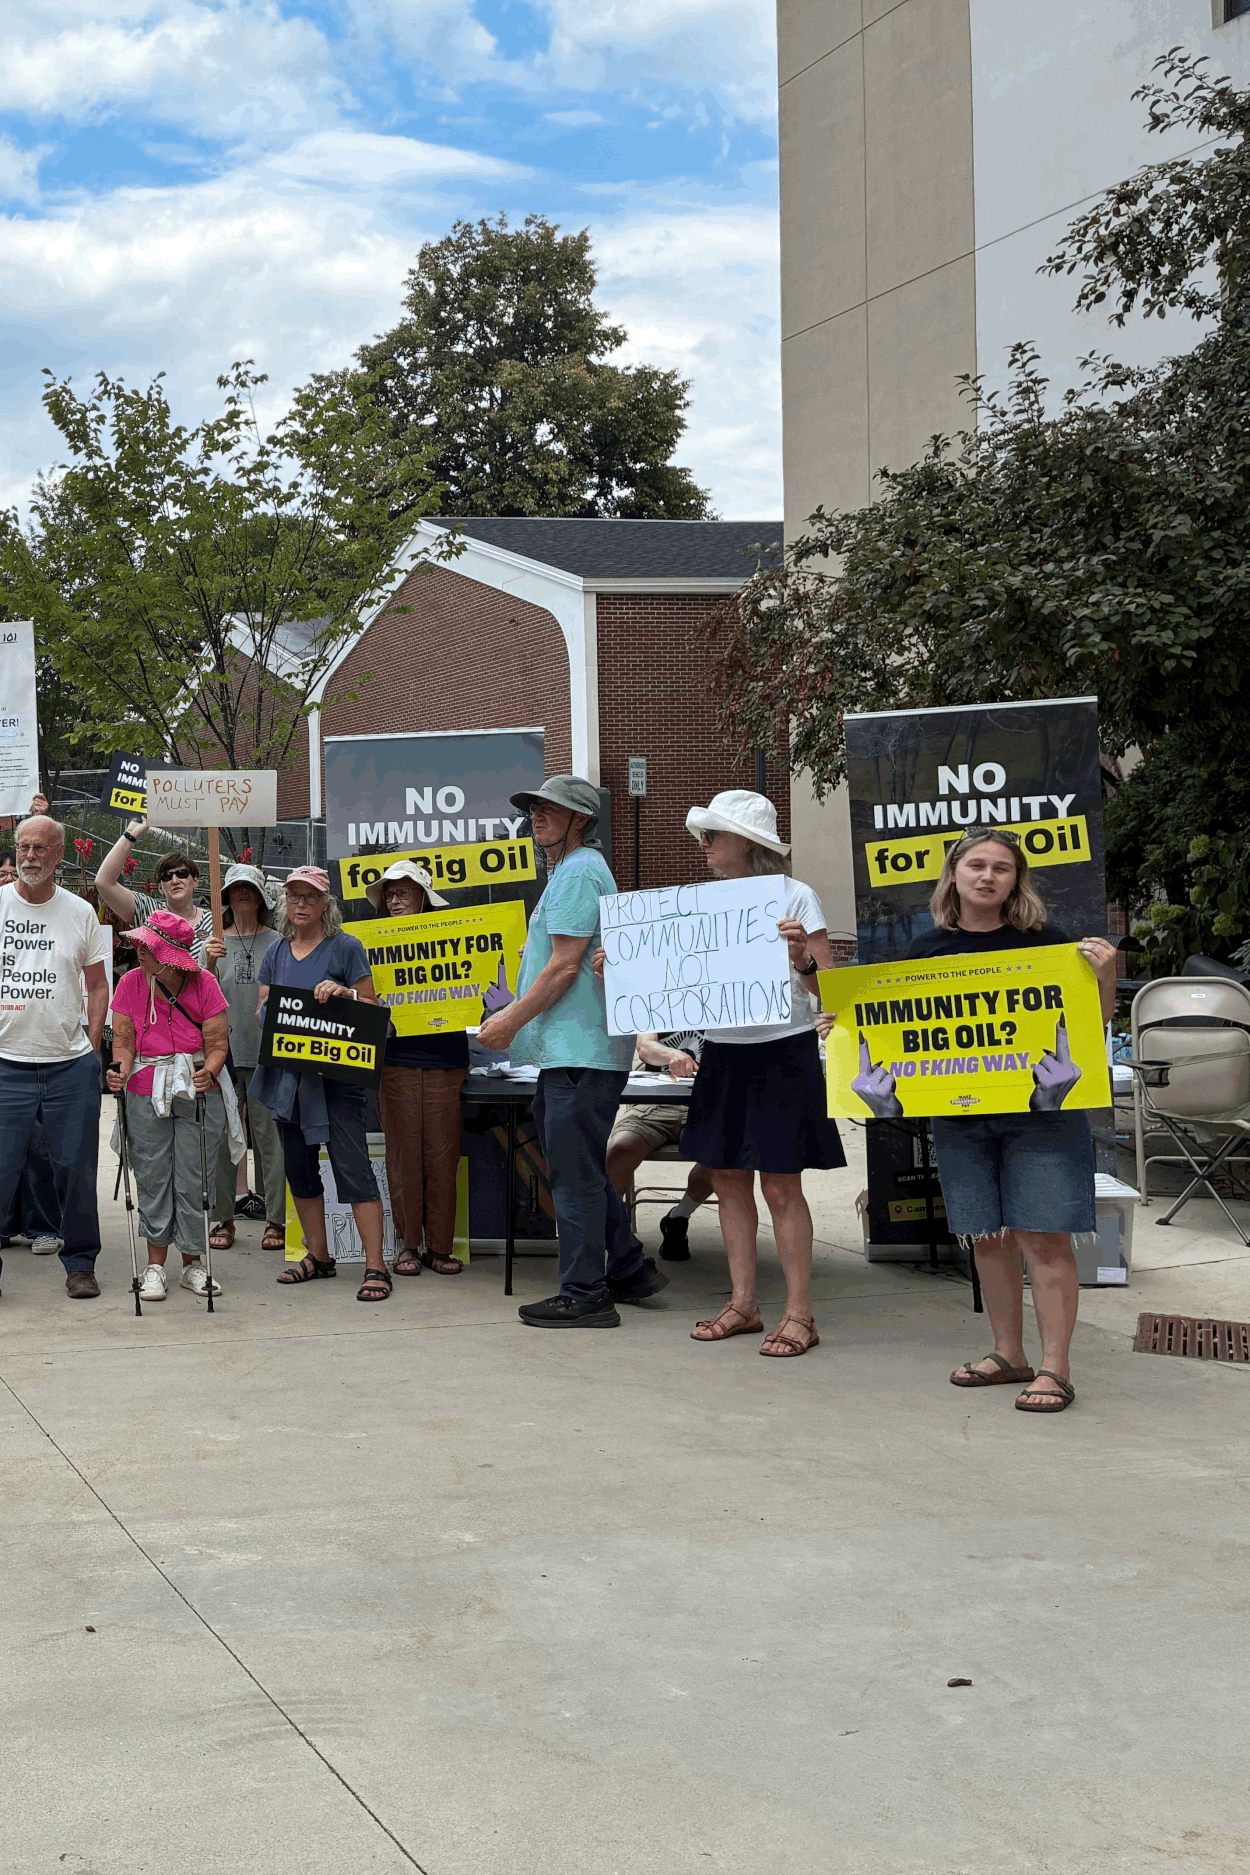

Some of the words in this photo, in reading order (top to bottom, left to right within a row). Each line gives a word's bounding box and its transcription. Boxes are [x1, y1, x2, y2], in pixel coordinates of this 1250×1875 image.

[3, 633, 17, 643] 101
[120, 760, 139, 773] NO
[937, 762, 1007, 795] NO
[114, 791, 137, 807] for
[152, 778, 252, 795] POLLUTERS
[156, 796, 205, 811] MUST
[220, 795, 248, 814] PAY
[405, 785, 465, 815] NO
[873, 793, 1076, 829] IMMUNITY
[348, 816, 525, 845] IMMUNITY
[479, 845, 529, 873] Oil
[875, 847, 930, 874] for
[1024, 824, 1082, 855] Oil
[604, 884, 707, 925] PROTECT
[5, 919, 47, 934] Solar
[397, 925, 419, 933] POWER
[440, 919, 463, 928] PEOPLE
[603, 900, 781, 966] COMMUNITIES
[3, 935, 55, 950] Power
[366, 937, 461, 966] MMUNITY
[465, 932, 504, 955] FOR
[2, 952, 16, 966] is
[664, 949, 720, 989] NOT
[1, 968, 57, 985] People
[394, 964, 428, 987] BIG
[431, 960, 473, 983] OIL?
[905, 973, 936, 983] POWER
[937, 971, 949, 980] TO
[950, 969, 967, 978] THE
[968, 966, 1002, 976] PEOPLE
[0, 984, 55, 999] Power.
[279, 996, 303, 1011] NO
[386, 992, 405, 1006] NO
[407, 987, 447, 1005] FKING
[614, 980, 791, 1034] CORPORATIONS
[854, 989, 1001, 1027] IMMUNITY
[1005, 984, 1065, 1013] FOR
[276, 1012, 356, 1038] IMMUNITY
[902, 1026, 950, 1053] BIG
[955, 1020, 1017, 1050] OIL?
[276, 1036, 305, 1053] for
[310, 1040, 342, 1061] Big
[346, 1045, 372, 1064] Oil
[889, 1059, 917, 1078] NO
[920, 1056, 979, 1077] FKING
